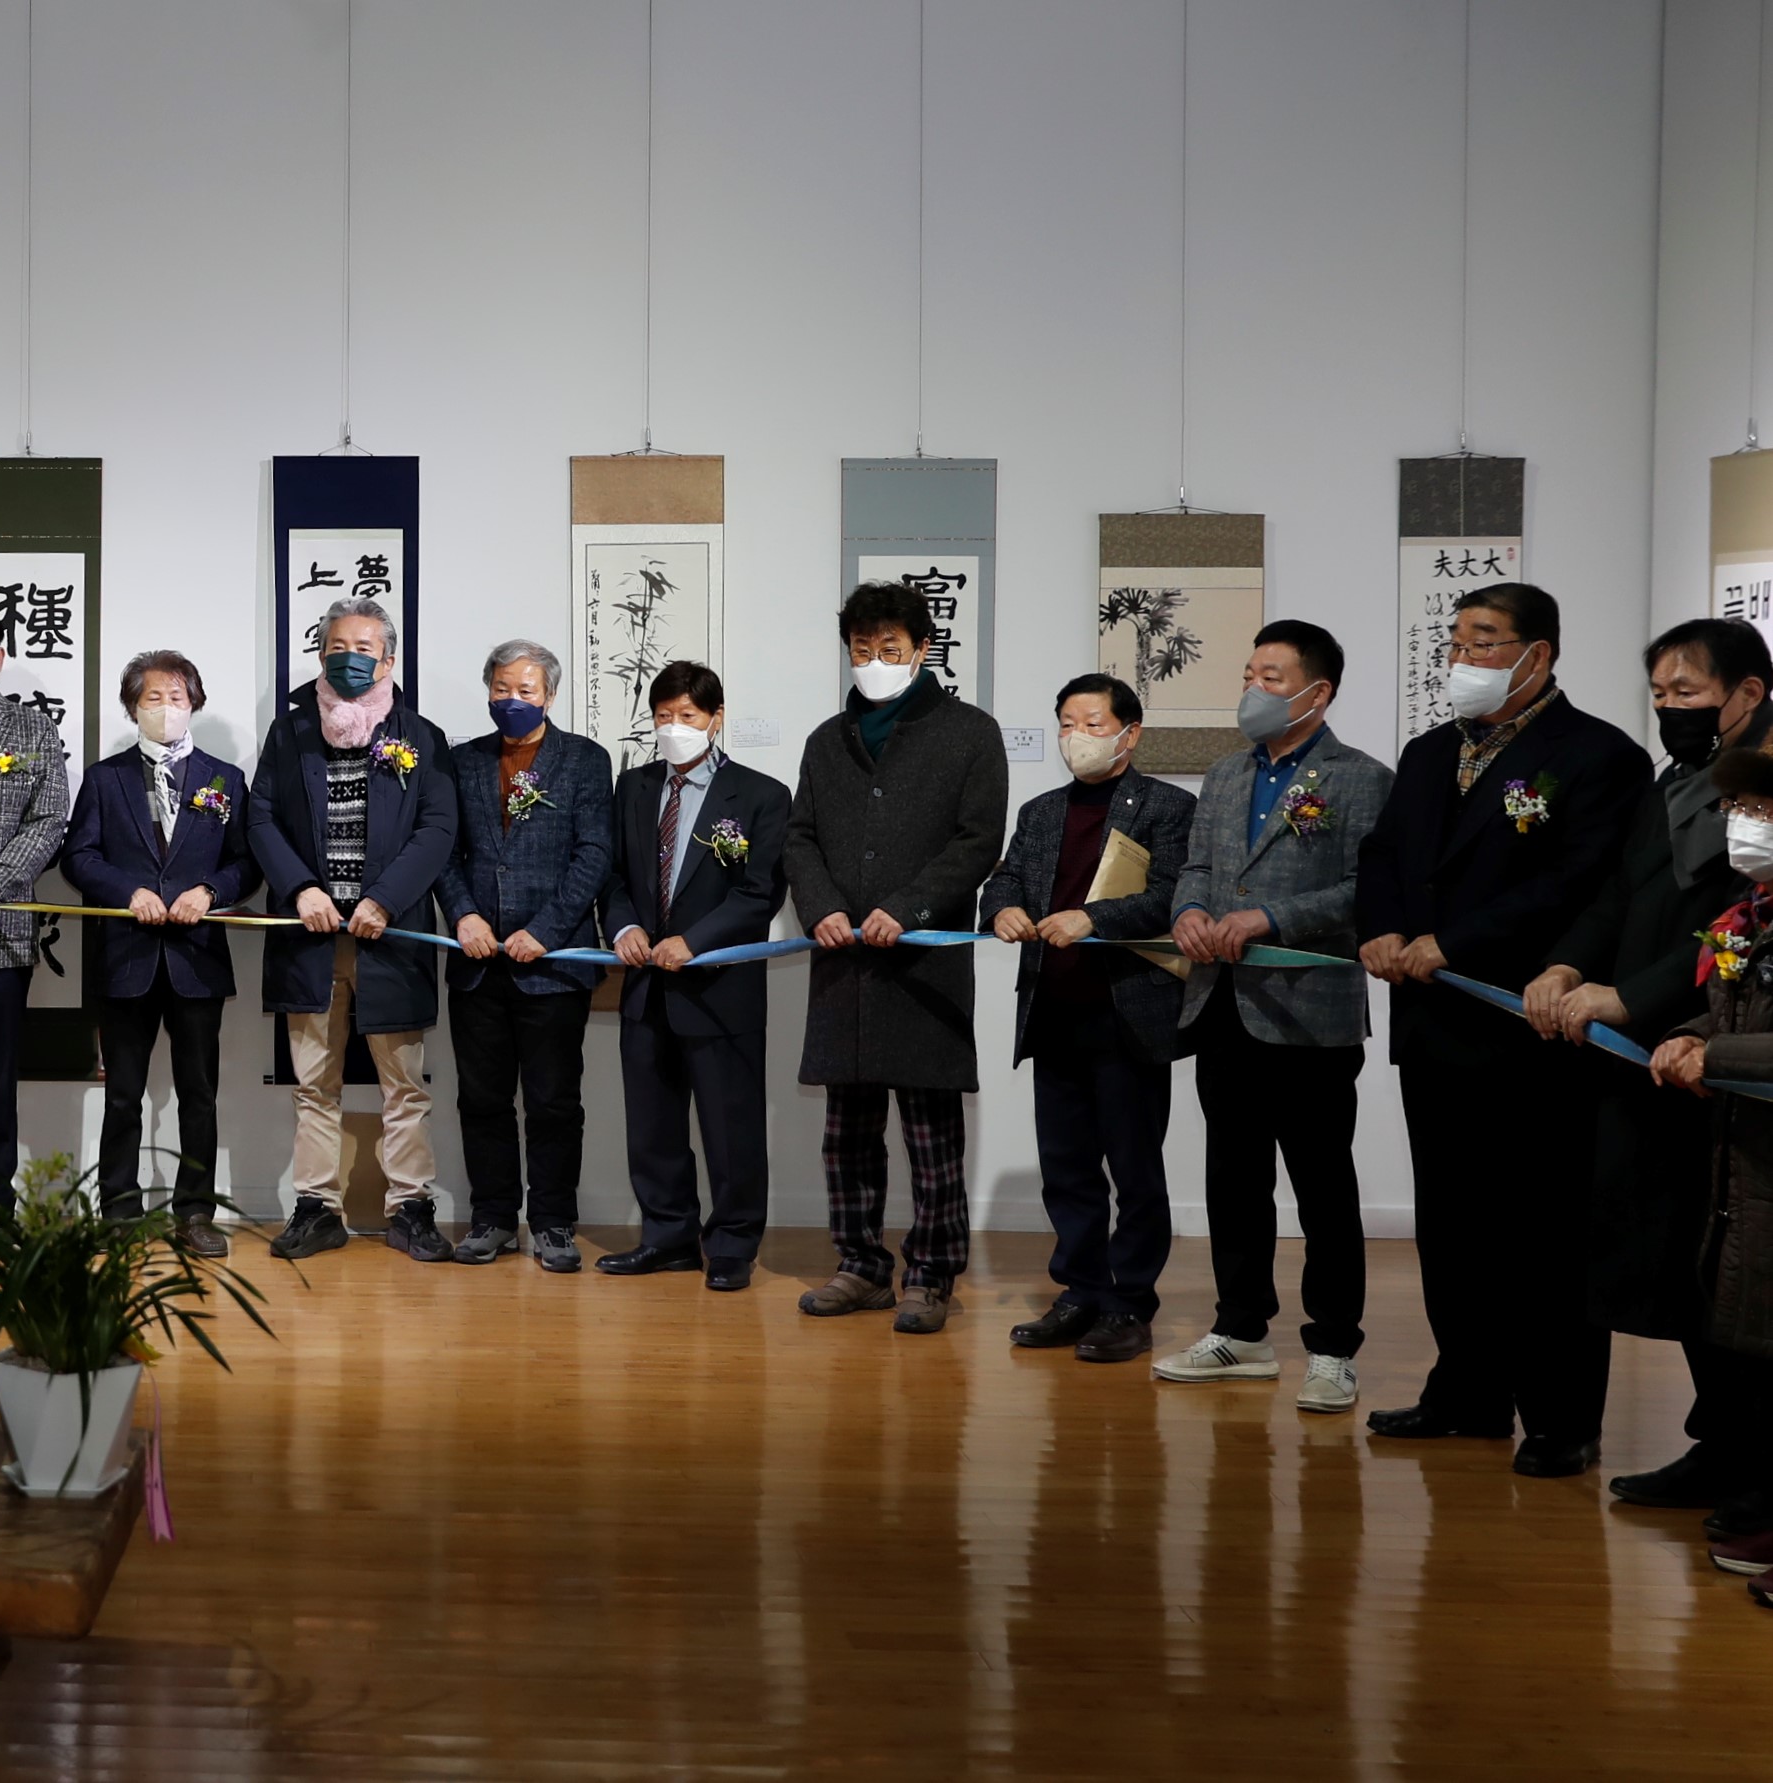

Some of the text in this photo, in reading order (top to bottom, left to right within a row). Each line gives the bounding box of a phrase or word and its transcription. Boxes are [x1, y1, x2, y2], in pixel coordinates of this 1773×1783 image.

[1432, 547, 1507, 579] 大丈夫
[901, 566, 967, 700] 富貴
